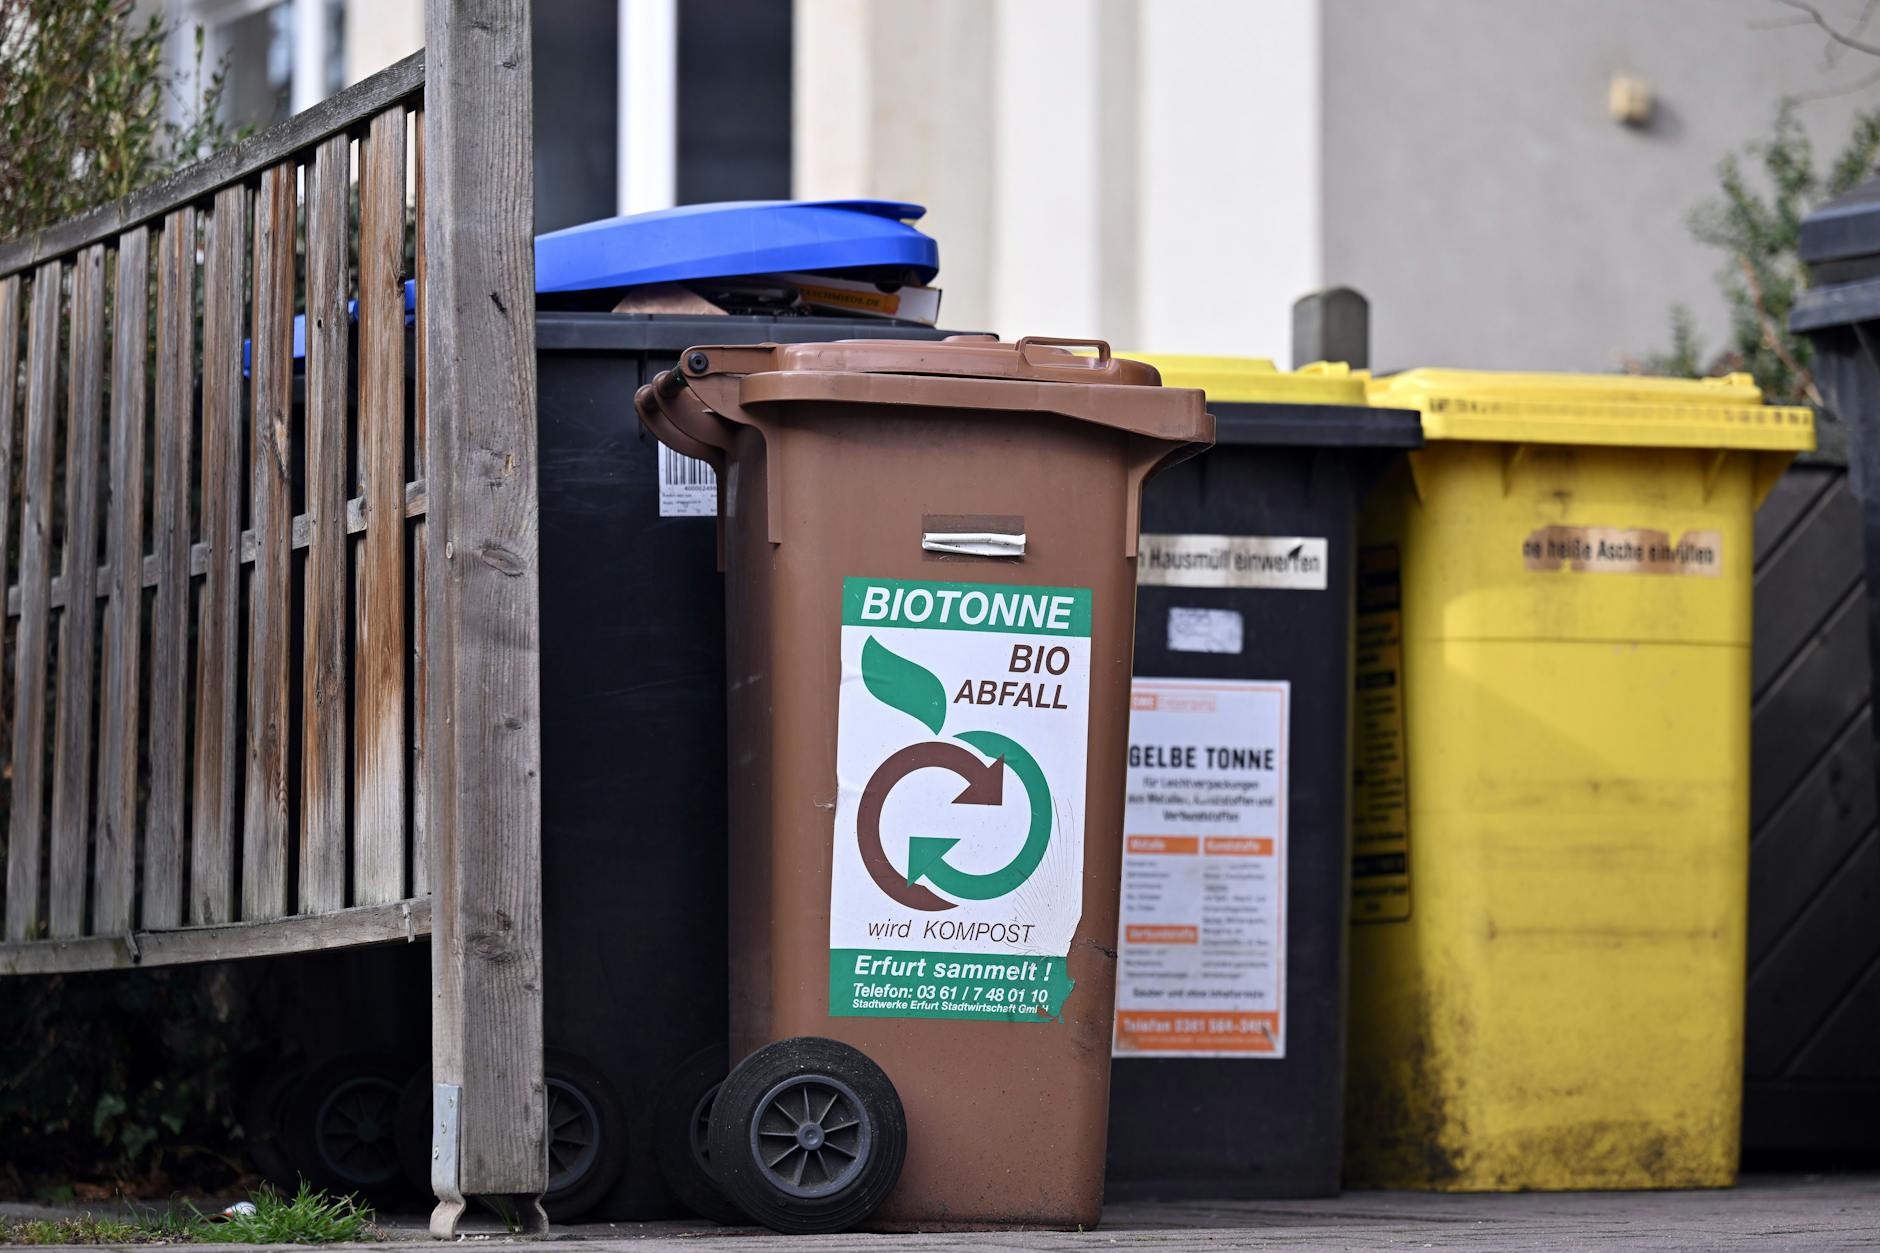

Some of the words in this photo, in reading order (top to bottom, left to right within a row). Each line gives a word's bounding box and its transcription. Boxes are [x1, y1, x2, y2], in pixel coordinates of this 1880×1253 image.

[1151, 550, 1229, 570] Hausmüll
[1234, 552, 1320, 573] einwerfen
[1597, 540, 1643, 562] Asche
[861, 586, 1074, 629] BIOTONNE
[1008, 644, 1070, 675] BIO
[953, 679, 1068, 709] ABFALL
[1129, 746, 1197, 769] GELBE
[1205, 748, 1274, 770] TONNE
[868, 918, 911, 938] wird
[923, 920, 1035, 943] KOMPOST
[854, 955, 926, 977] Erfurt
[933, 961, 1037, 981] sammelt
[1044, 962, 1052, 981] !
[853, 983, 913, 998] Telefon:
[917, 985, 936, 1000] 03
[940, 986, 957, 1000] 61
[962, 986, 969, 1000] /
[974, 987, 983, 1000] 7
[985, 988, 1004, 1002] 48
[1007, 988, 1025, 1003] 01
[1031, 989, 1048, 1003] 10
[852, 998, 908, 1009] Stadtwerke
[910, 1000, 939, 1010] Erfurt
[941, 1001, 1016, 1013] Stadtwirtschaft
